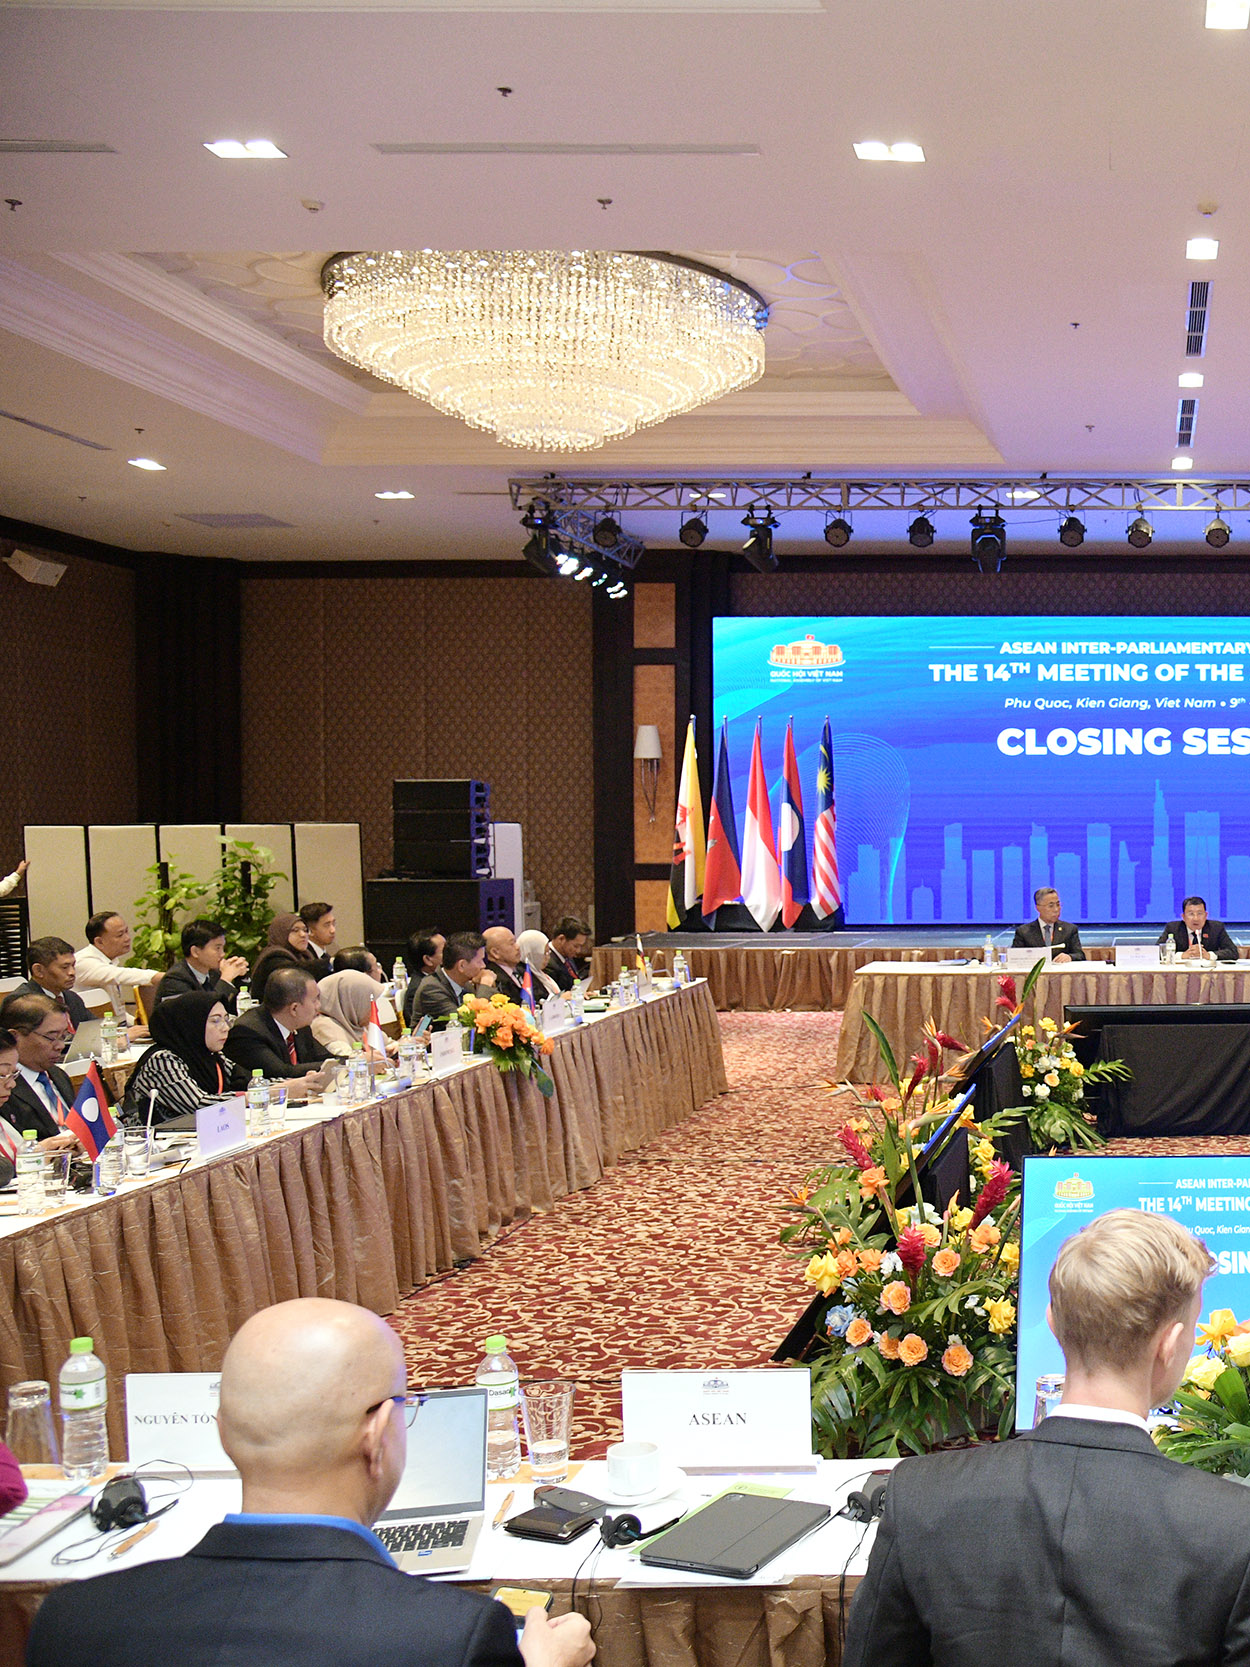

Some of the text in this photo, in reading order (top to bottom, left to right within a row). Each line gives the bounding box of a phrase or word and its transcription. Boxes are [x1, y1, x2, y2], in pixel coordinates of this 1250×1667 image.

[1000, 642, 1056, 654] ASEAN
[928, 664, 978, 682] THE
[984, 662, 1030, 682] 14TH
[1038, 664, 1148, 682] MEETING
[1155, 664, 1189, 682] OF
[1195, 664, 1244, 682] THE
[1004, 698, 1031, 708] Phu
[1034, 698, 1072, 710] Quoc,
[1076, 698, 1105, 708] Kien
[1108, 698, 1151, 711] Giang,
[1155, 698, 1180, 708] Viet
[1184, 698, 1216, 708] Nam
[997, 727, 1172, 756] CLOSING
[1175, 1179, 1206, 1189] ASEAN
[1138, 1197, 1165, 1212] THE
[1194, 1225, 1216, 1236] Quoc,
[1216, 1224, 1233, 1234] Kien
[689, 1412, 747, 1425] ASEAN
